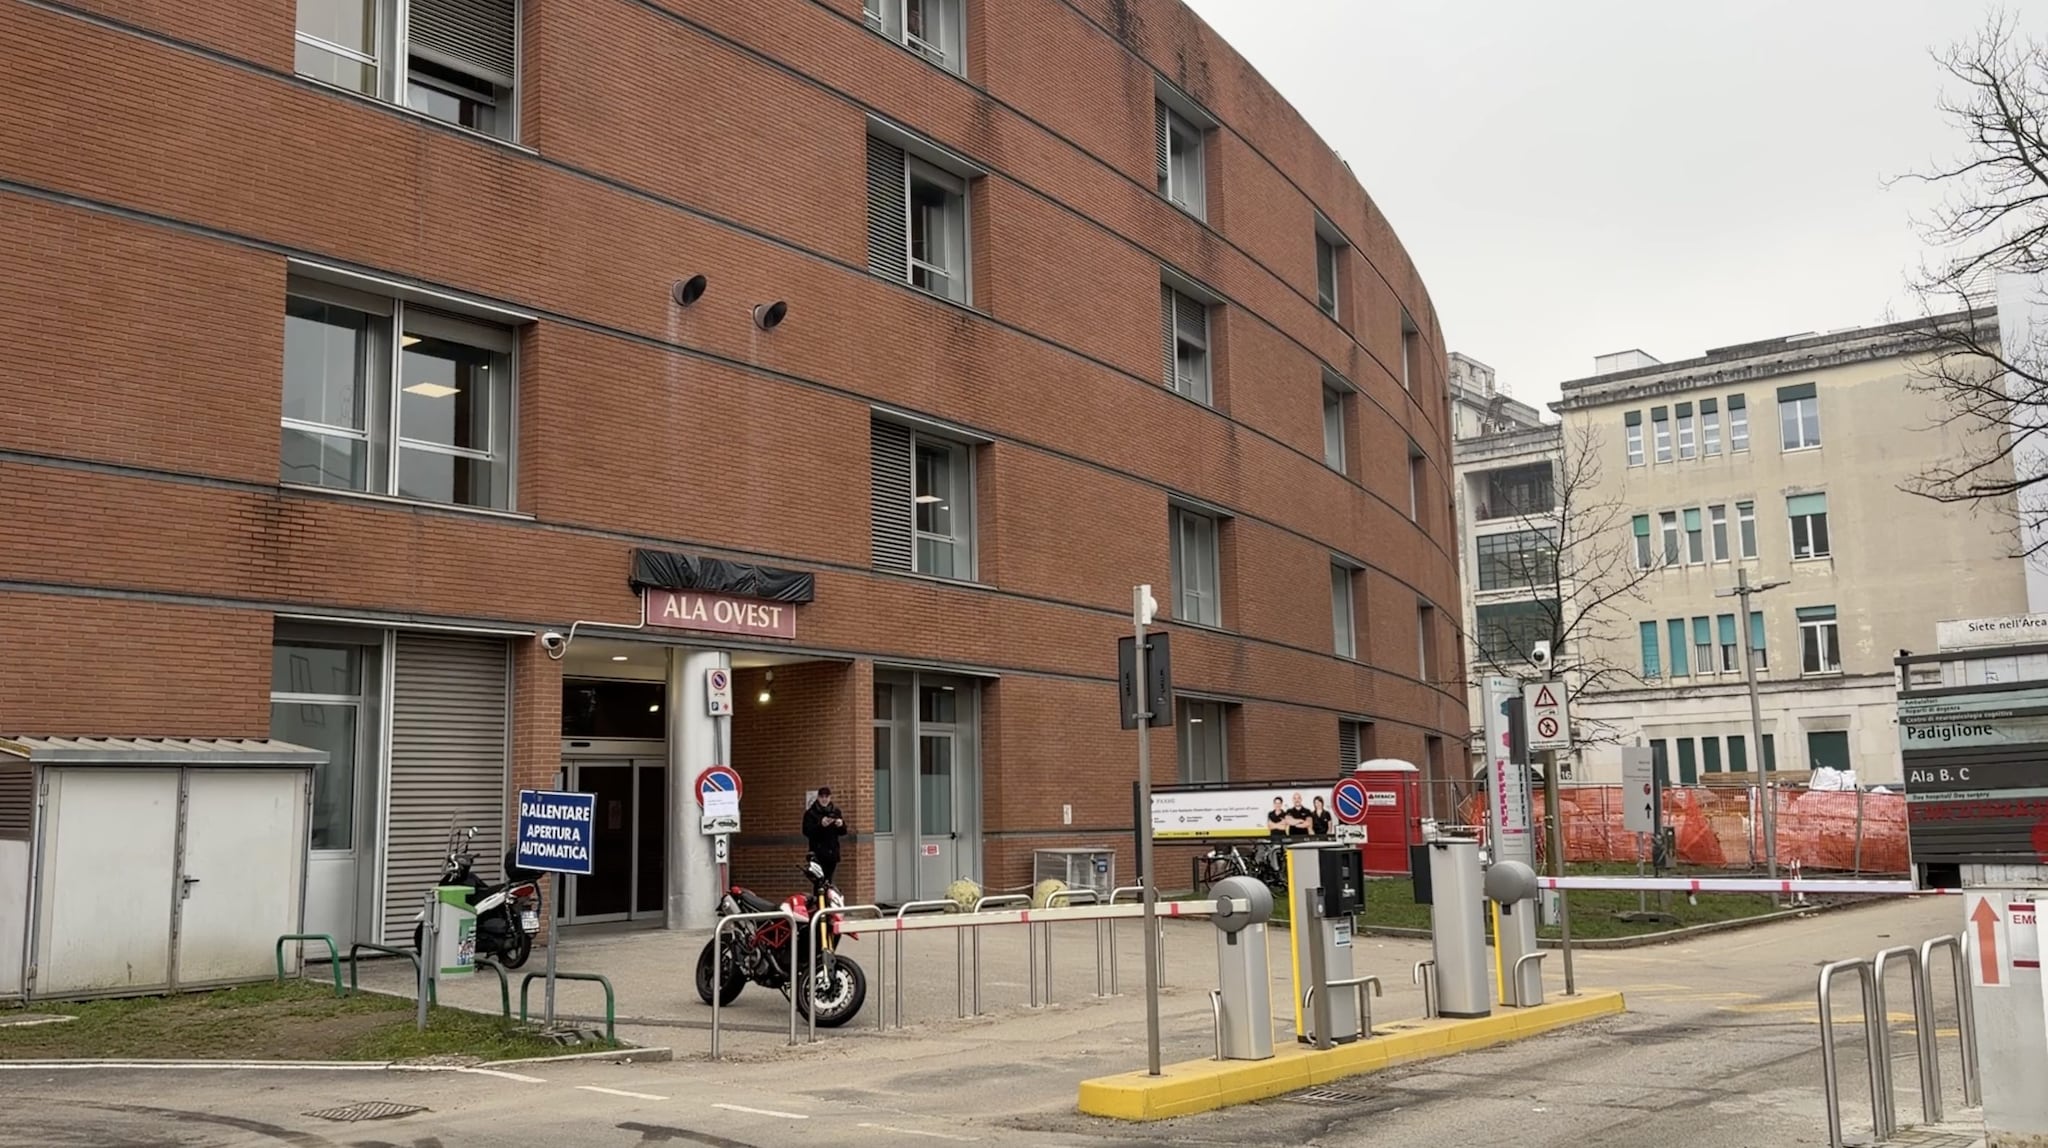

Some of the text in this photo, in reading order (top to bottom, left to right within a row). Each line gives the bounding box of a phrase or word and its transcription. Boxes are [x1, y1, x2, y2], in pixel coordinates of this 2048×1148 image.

[664, 594, 783, 628] ALA OVEST
[1968, 622, 1995, 632] Siete
[1907, 724, 1993, 741] Padiglione
[1561, 771, 1572, 780] 16
[1911, 768, 1970, 783] Ala B. C
[521, 803, 590, 821] RALLENTARE
[527, 824, 580, 841] APERTURA
[520, 841, 588, 860] AUTOMATICA
